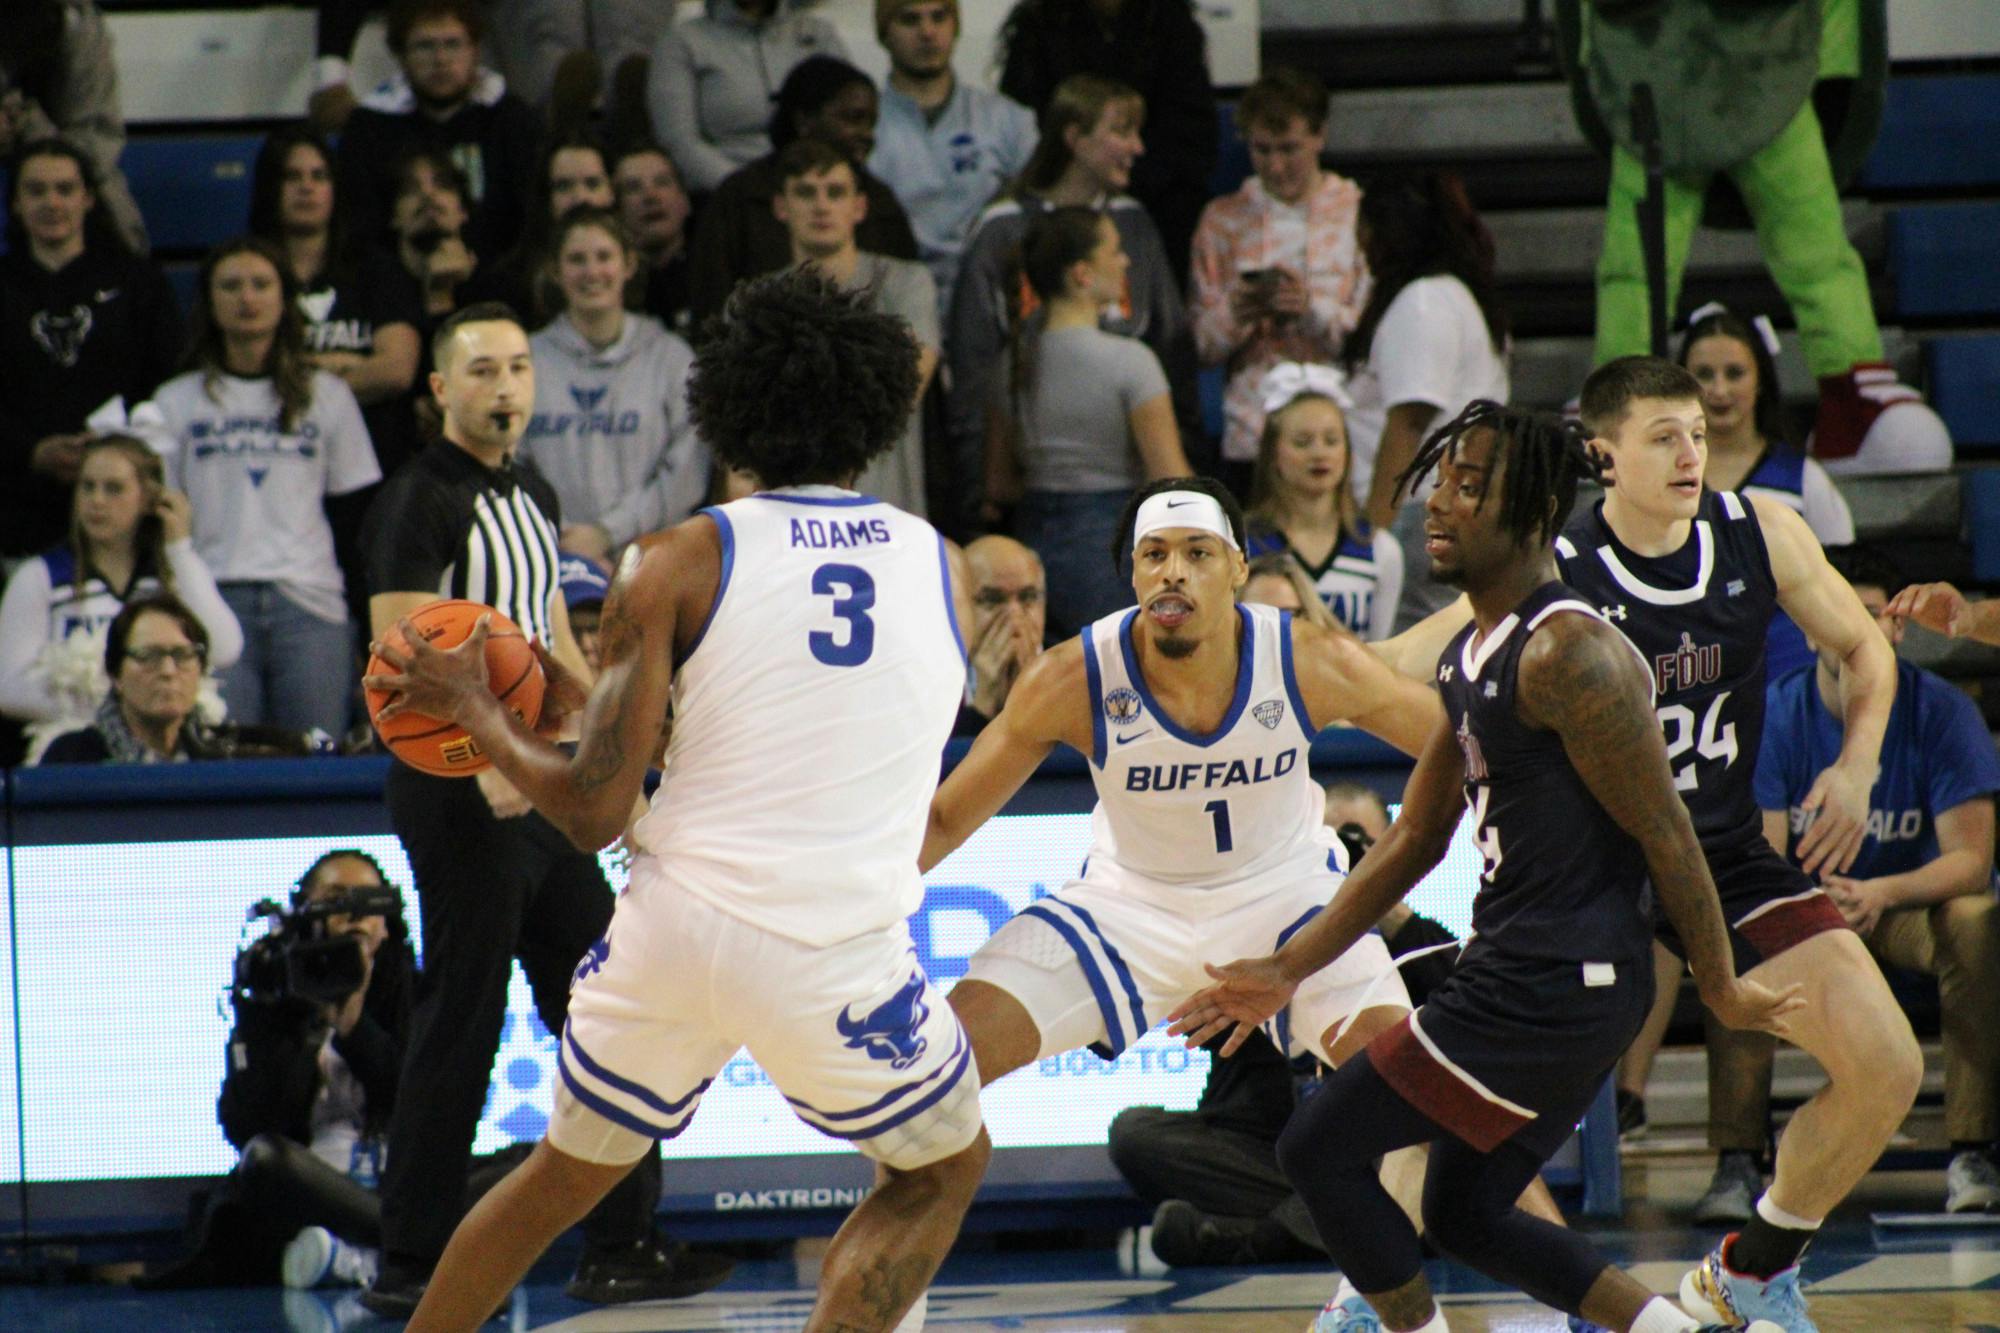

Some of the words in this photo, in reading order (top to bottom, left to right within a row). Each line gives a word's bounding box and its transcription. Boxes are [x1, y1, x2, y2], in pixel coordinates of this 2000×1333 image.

[790, 518, 891, 548] ADAMS
[809, 562, 876, 668] 3
[1656, 640, 1721, 695] FDU
[1656, 691, 1738, 791] 24
[1126, 748, 1297, 792] BUFFALO
[1204, 799, 1233, 853] 1
[1789, 805, 1923, 843] BALO
[715, 1187, 874, 1211] DAKTRONI
